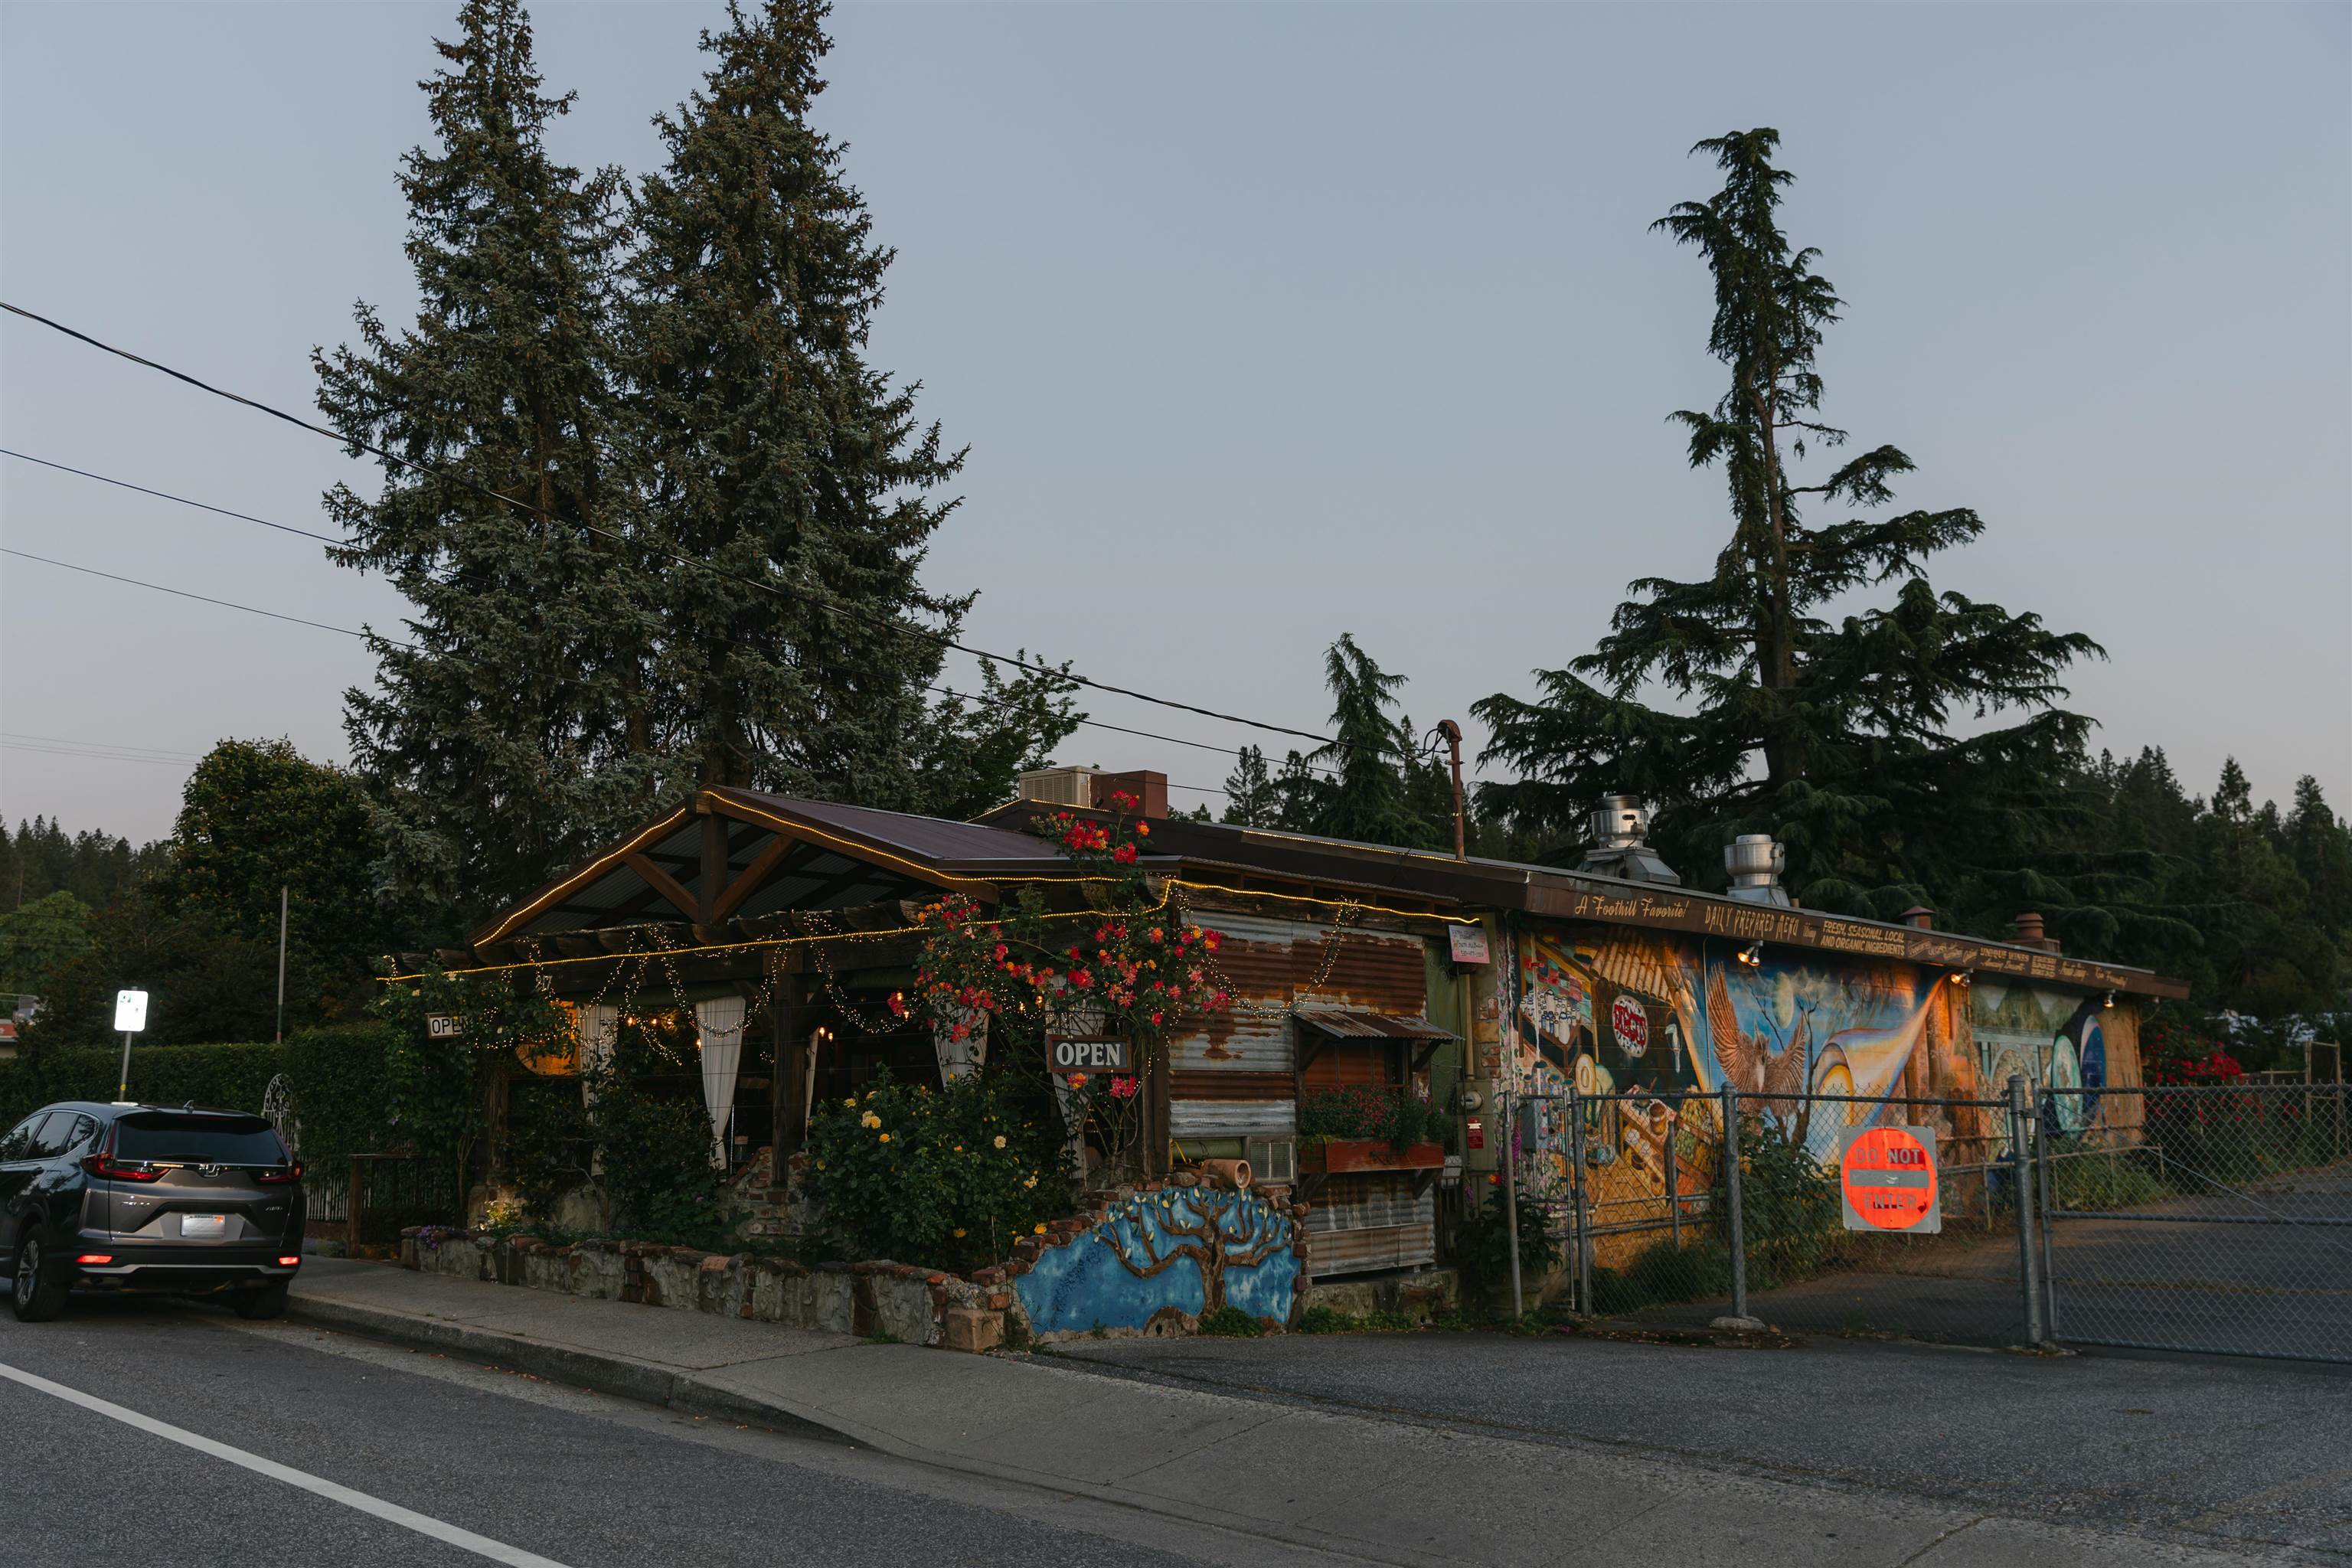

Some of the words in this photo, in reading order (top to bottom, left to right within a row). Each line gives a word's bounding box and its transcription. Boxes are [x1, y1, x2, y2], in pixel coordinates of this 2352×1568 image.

[1575, 895, 1587, 915] A
[1592, 896, 1638, 917] Foothill
[1641, 897, 1690, 918] Favorite!
[1704, 905, 1733, 932] DAILY
[1733, 910, 1775, 937] PREPARED
[1776, 915, 1799, 941] MENU
[1822, 920, 1847, 936] FRESH,
[1884, 930, 1905, 943] LOCAL
[1821, 936, 1835, 947] AND
[1835, 938, 1865, 951] ORGANIC
[1865, 942, 1905, 956] INGREDIENTS
[1980, 946, 2007, 959] UNIQUE
[2008, 951, 2030, 962] WINES
[1056, 1043, 1121, 1066] OPEN
[1855, 1148, 1877, 1163] DO
[1887, 1148, 1920, 1164] NOT
[1864, 1193, 1916, 1212] ENTER
